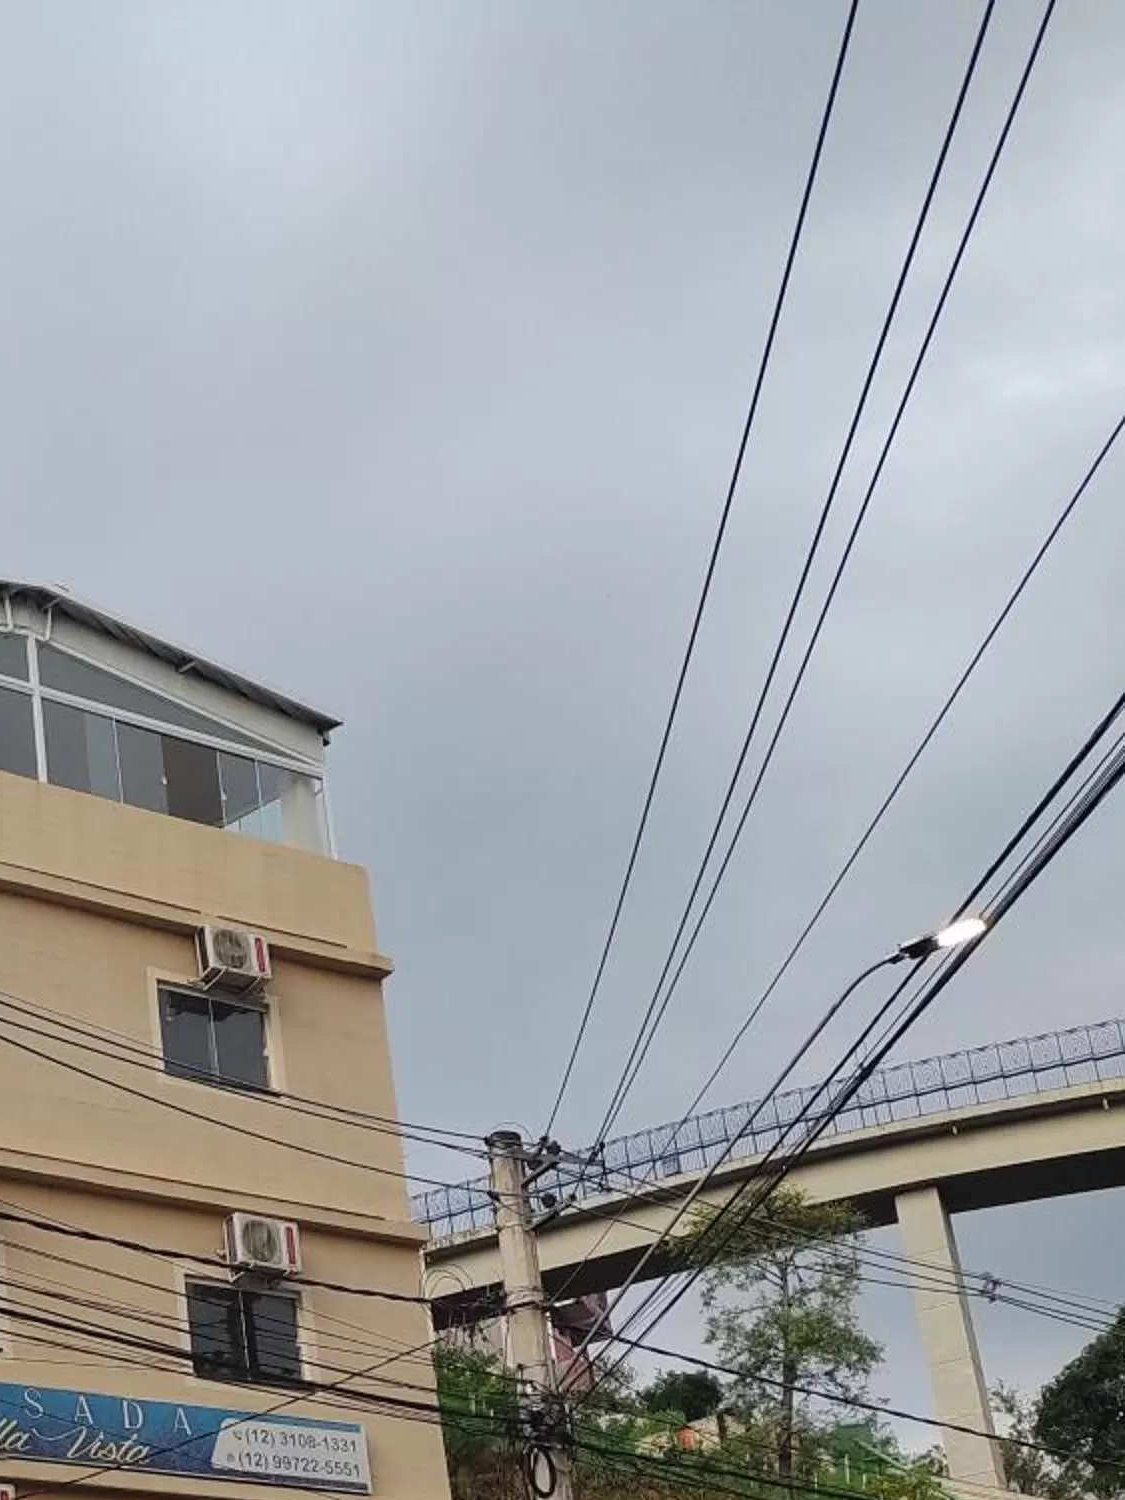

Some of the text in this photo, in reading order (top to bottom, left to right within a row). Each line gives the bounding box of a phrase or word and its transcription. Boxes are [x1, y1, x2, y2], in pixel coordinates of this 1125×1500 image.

[33, 1424, 152, 1465] Vista
[245, 1429, 357, 1453] (12) 3108-1331
[238, 1452, 360, 1478] (12) 99722-5551
